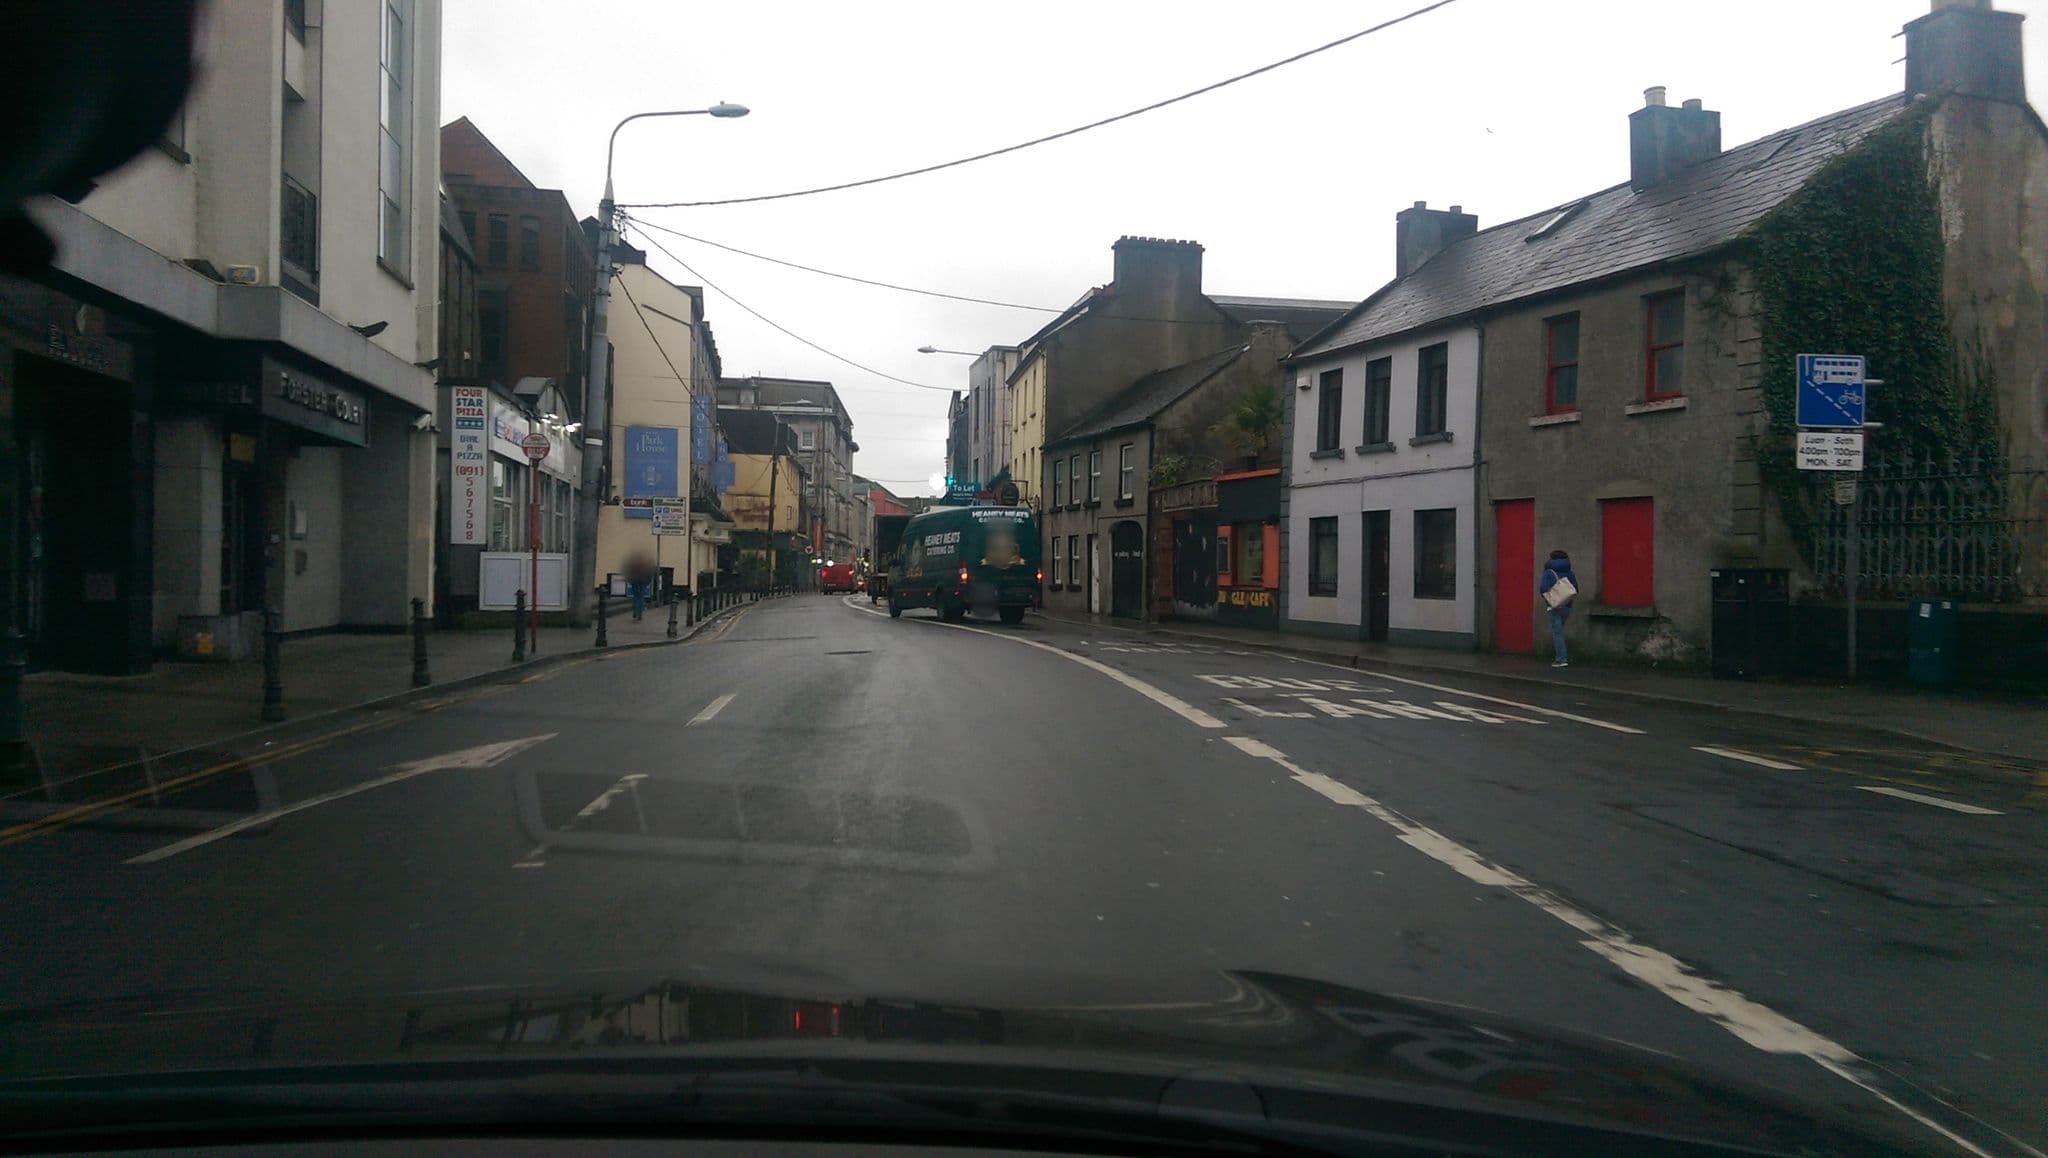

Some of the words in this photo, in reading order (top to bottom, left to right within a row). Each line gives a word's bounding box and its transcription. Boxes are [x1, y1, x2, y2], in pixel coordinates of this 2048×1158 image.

[455, 388, 483, 398] FOUR
[455, 398, 483, 407] STAR
[456, 408, 484, 416] PIZZA
[456, 452, 483, 460] PIZZA
[963, 484, 975, 492] Let
[1192, 673, 1395, 694] BUS
